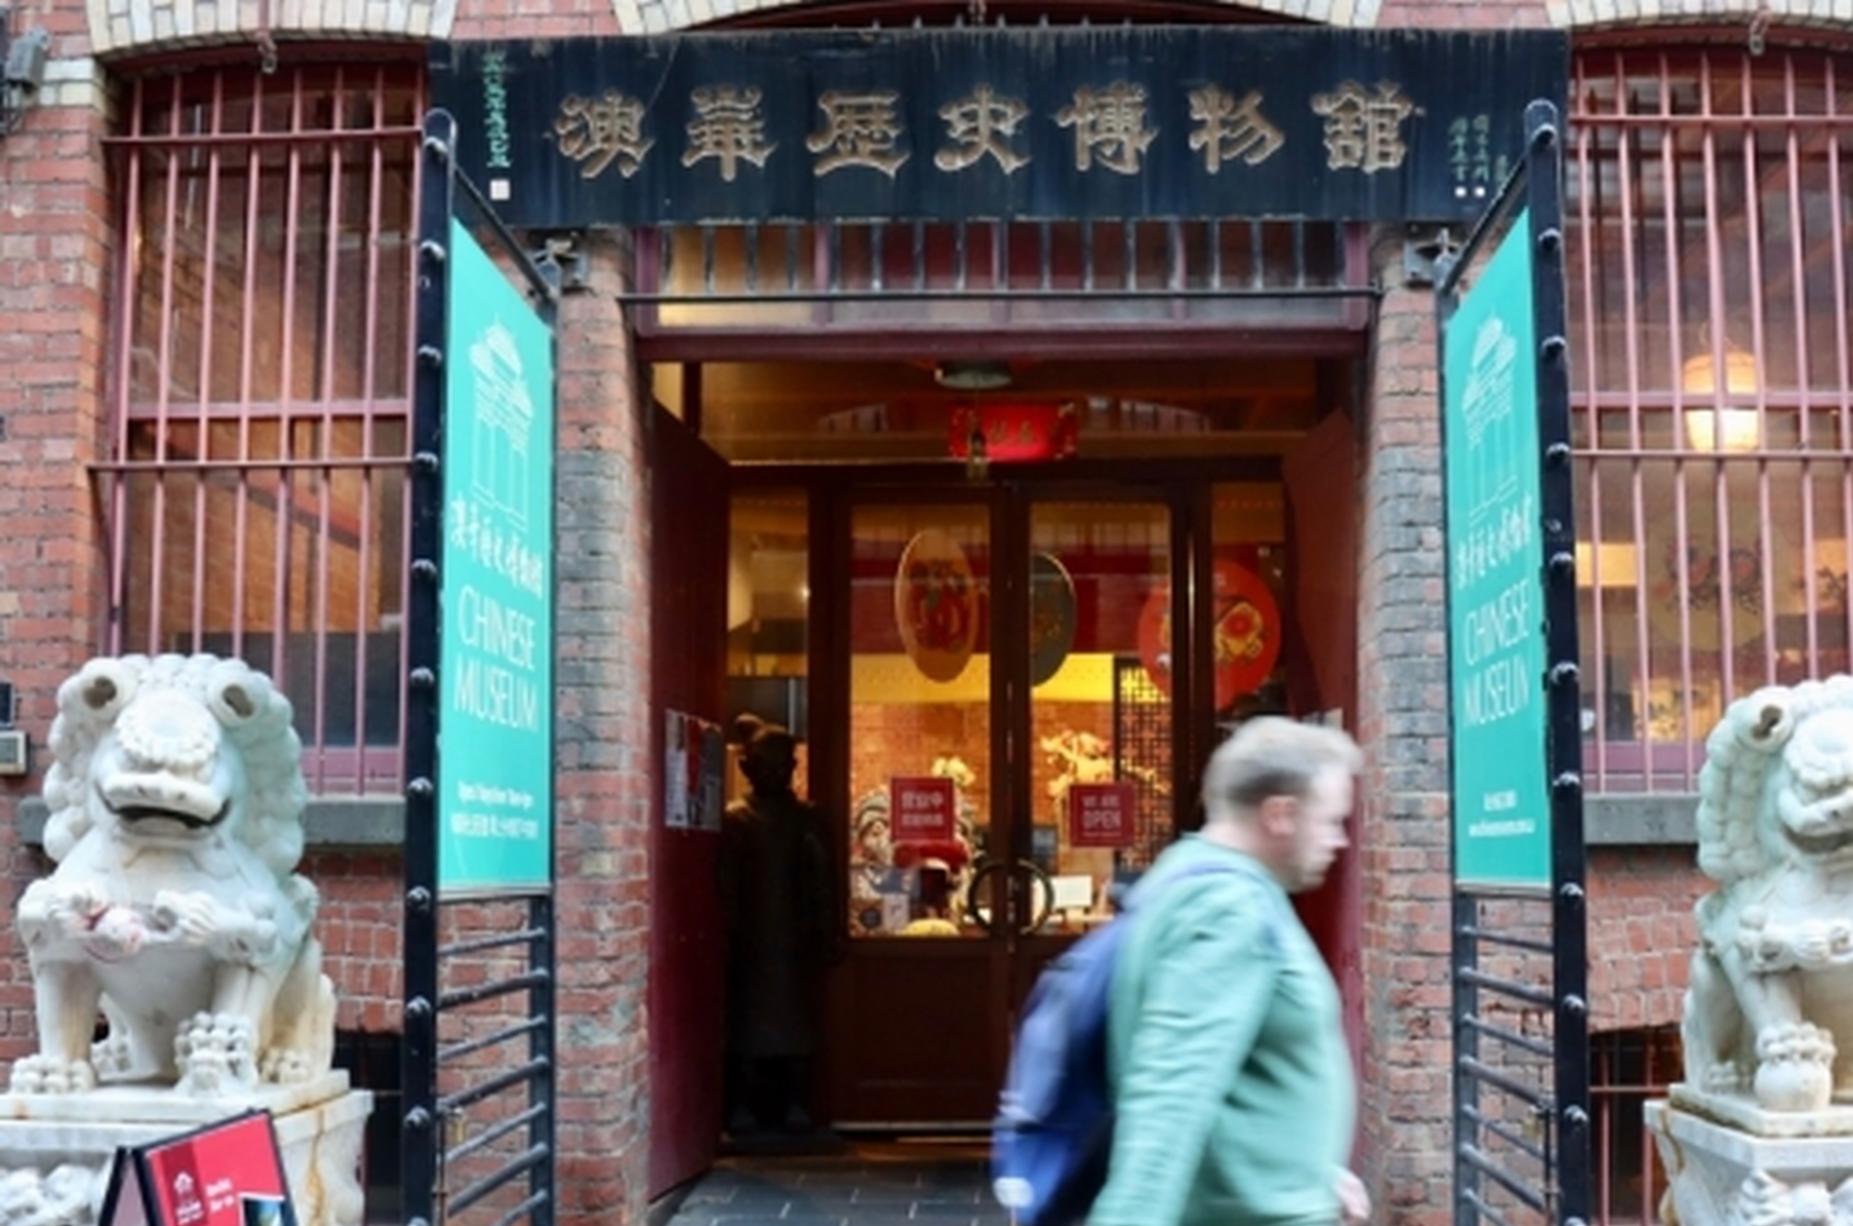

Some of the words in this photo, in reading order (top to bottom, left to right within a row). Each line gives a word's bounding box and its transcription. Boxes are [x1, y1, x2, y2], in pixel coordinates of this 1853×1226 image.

[458, 584, 535, 672] CHINESE
[1464, 578, 1530, 666] CHINESE
[453, 651, 539, 733] MUSEUM
[1463, 653, 1530, 728] MUSEUM
[1082, 809, 1122, 830] OPEN
